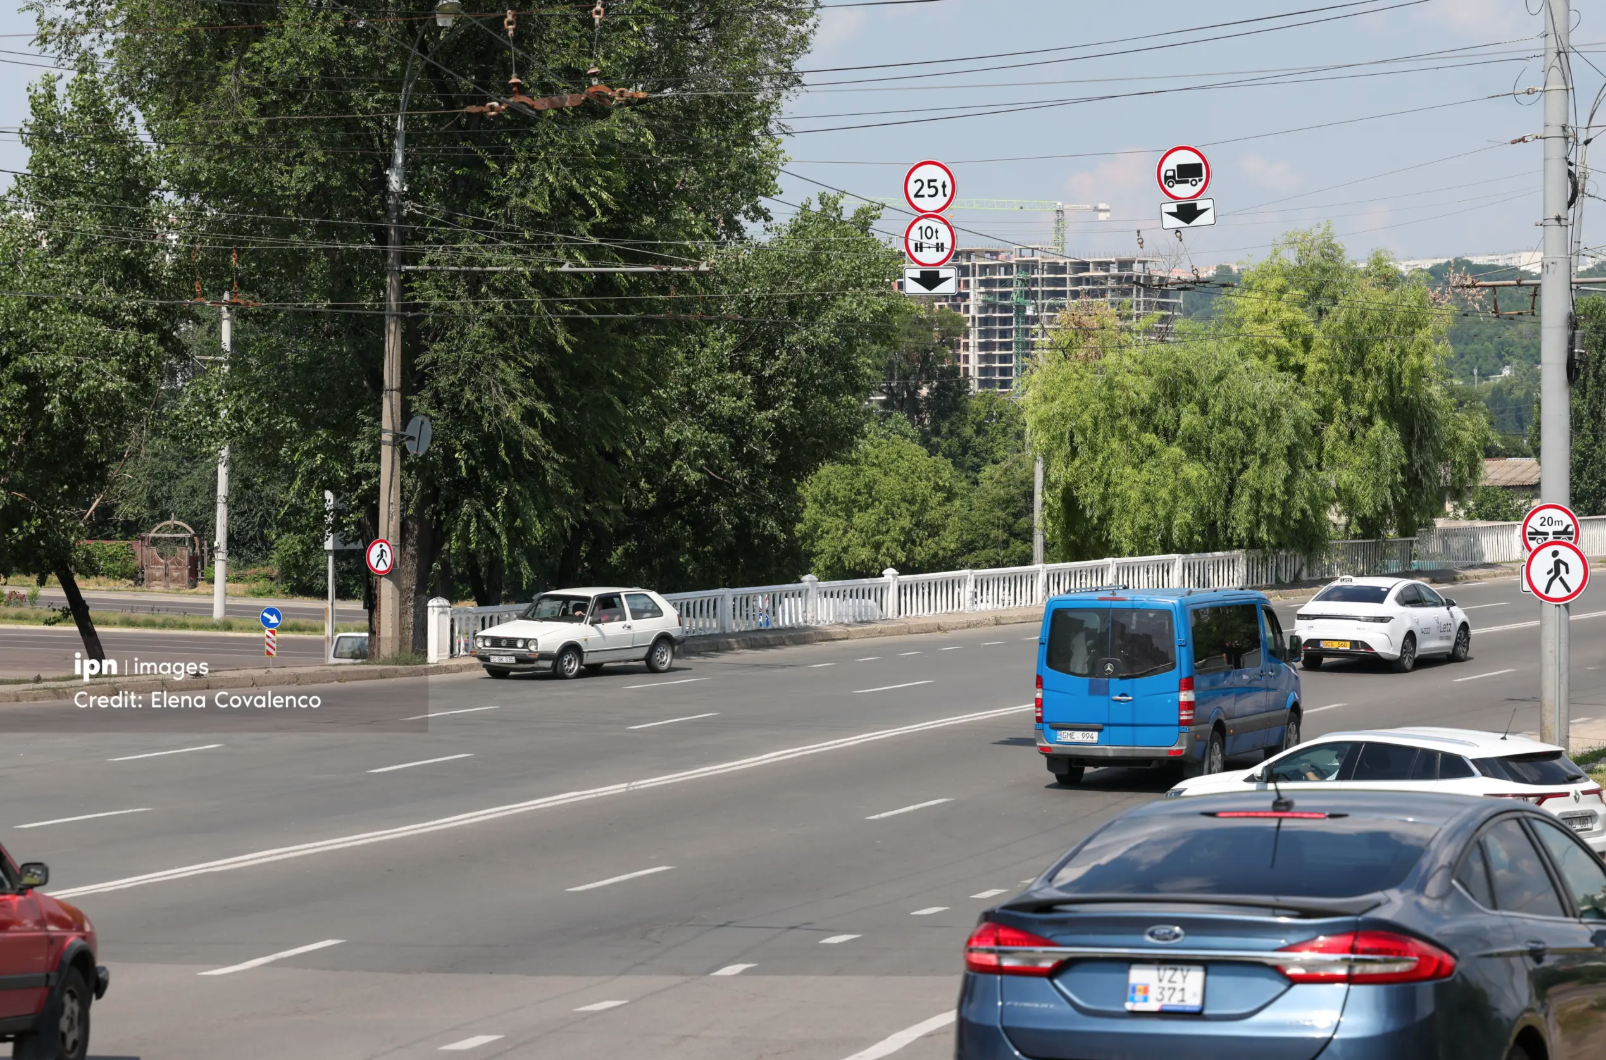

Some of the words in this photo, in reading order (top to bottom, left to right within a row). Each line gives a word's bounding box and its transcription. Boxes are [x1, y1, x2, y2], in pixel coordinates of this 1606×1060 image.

[913, 178, 947, 198] 25t
[917, 225, 939, 240] 10t
[1539, 516, 1564, 527] 20m
[1439, 622, 1452, 633] Letz
[1062, 731, 1076, 740] GME
[1081, 732, 1094, 740] 994
[1156, 966, 1191, 984] VZY
[1155, 986, 1187, 1003] 371
